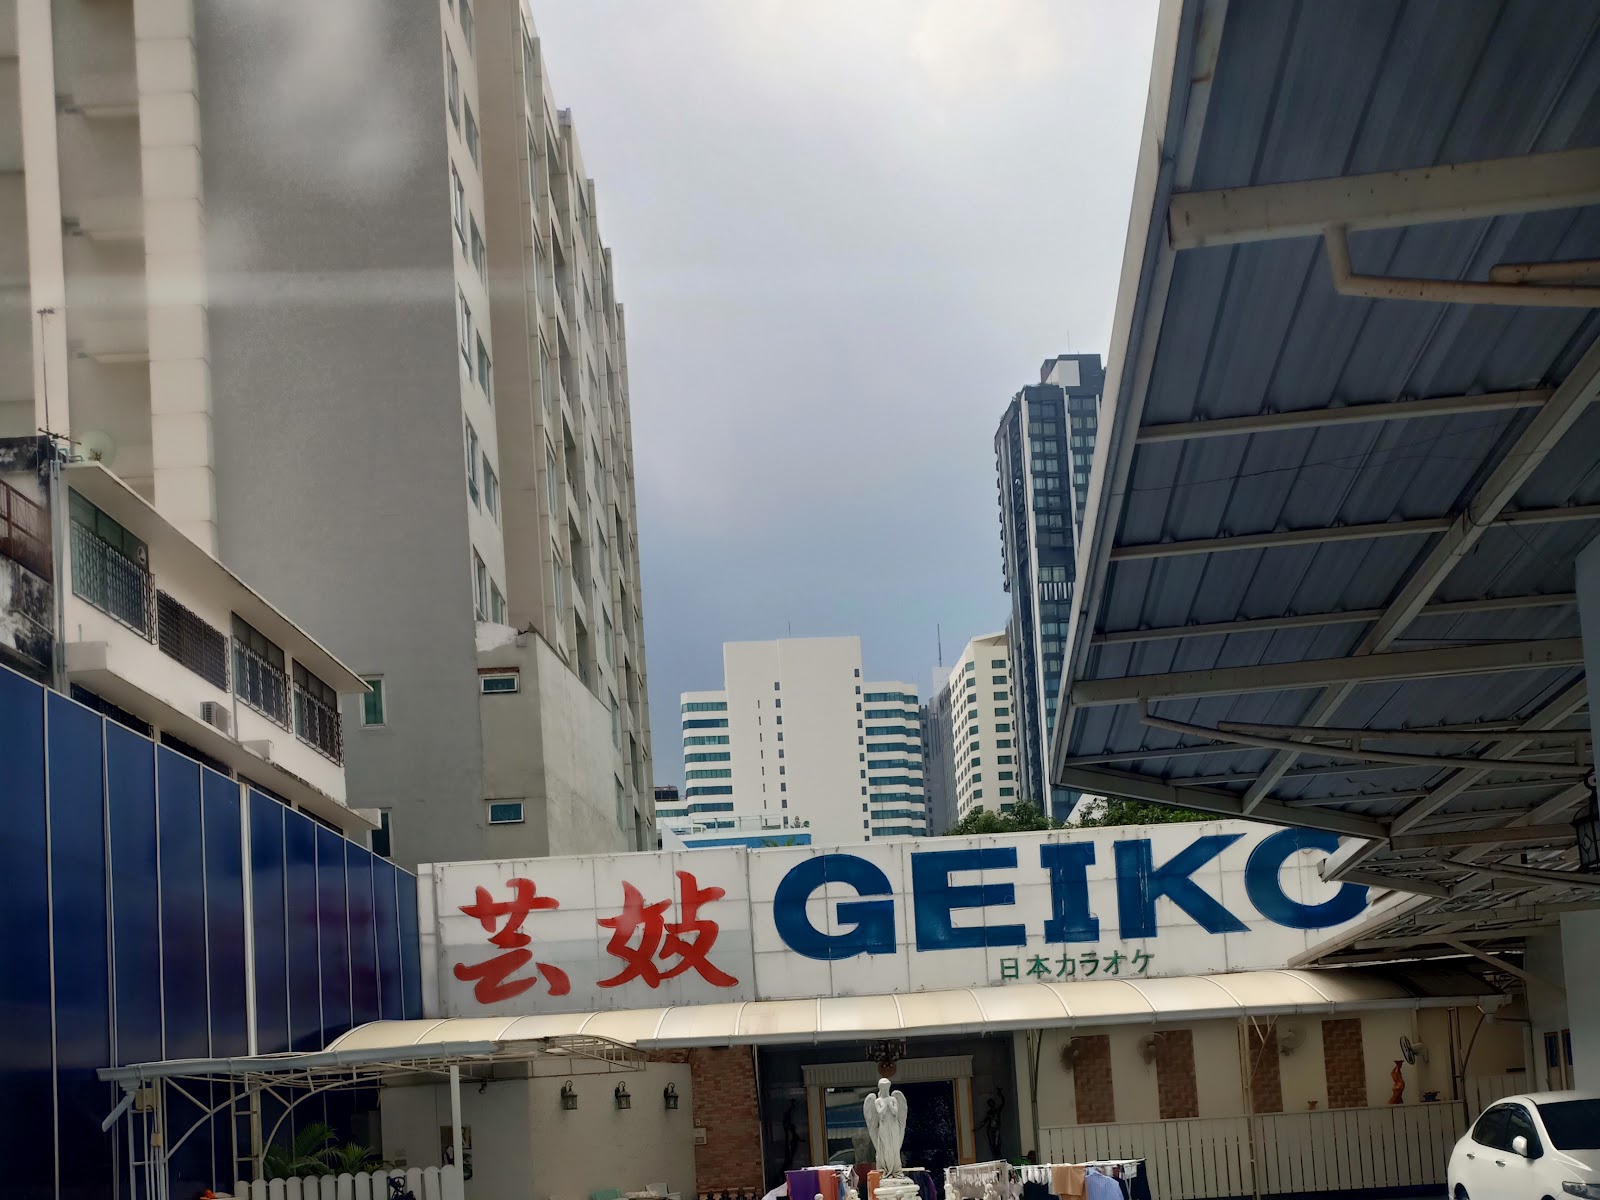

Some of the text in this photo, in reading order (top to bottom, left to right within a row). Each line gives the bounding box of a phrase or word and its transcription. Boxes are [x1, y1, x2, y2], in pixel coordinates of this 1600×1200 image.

[453, 870, 739, 1004] 芸妓
[773, 827, 1371, 961] GEIKO
[1000, 949, 1155, 980] 日本カラオケ
